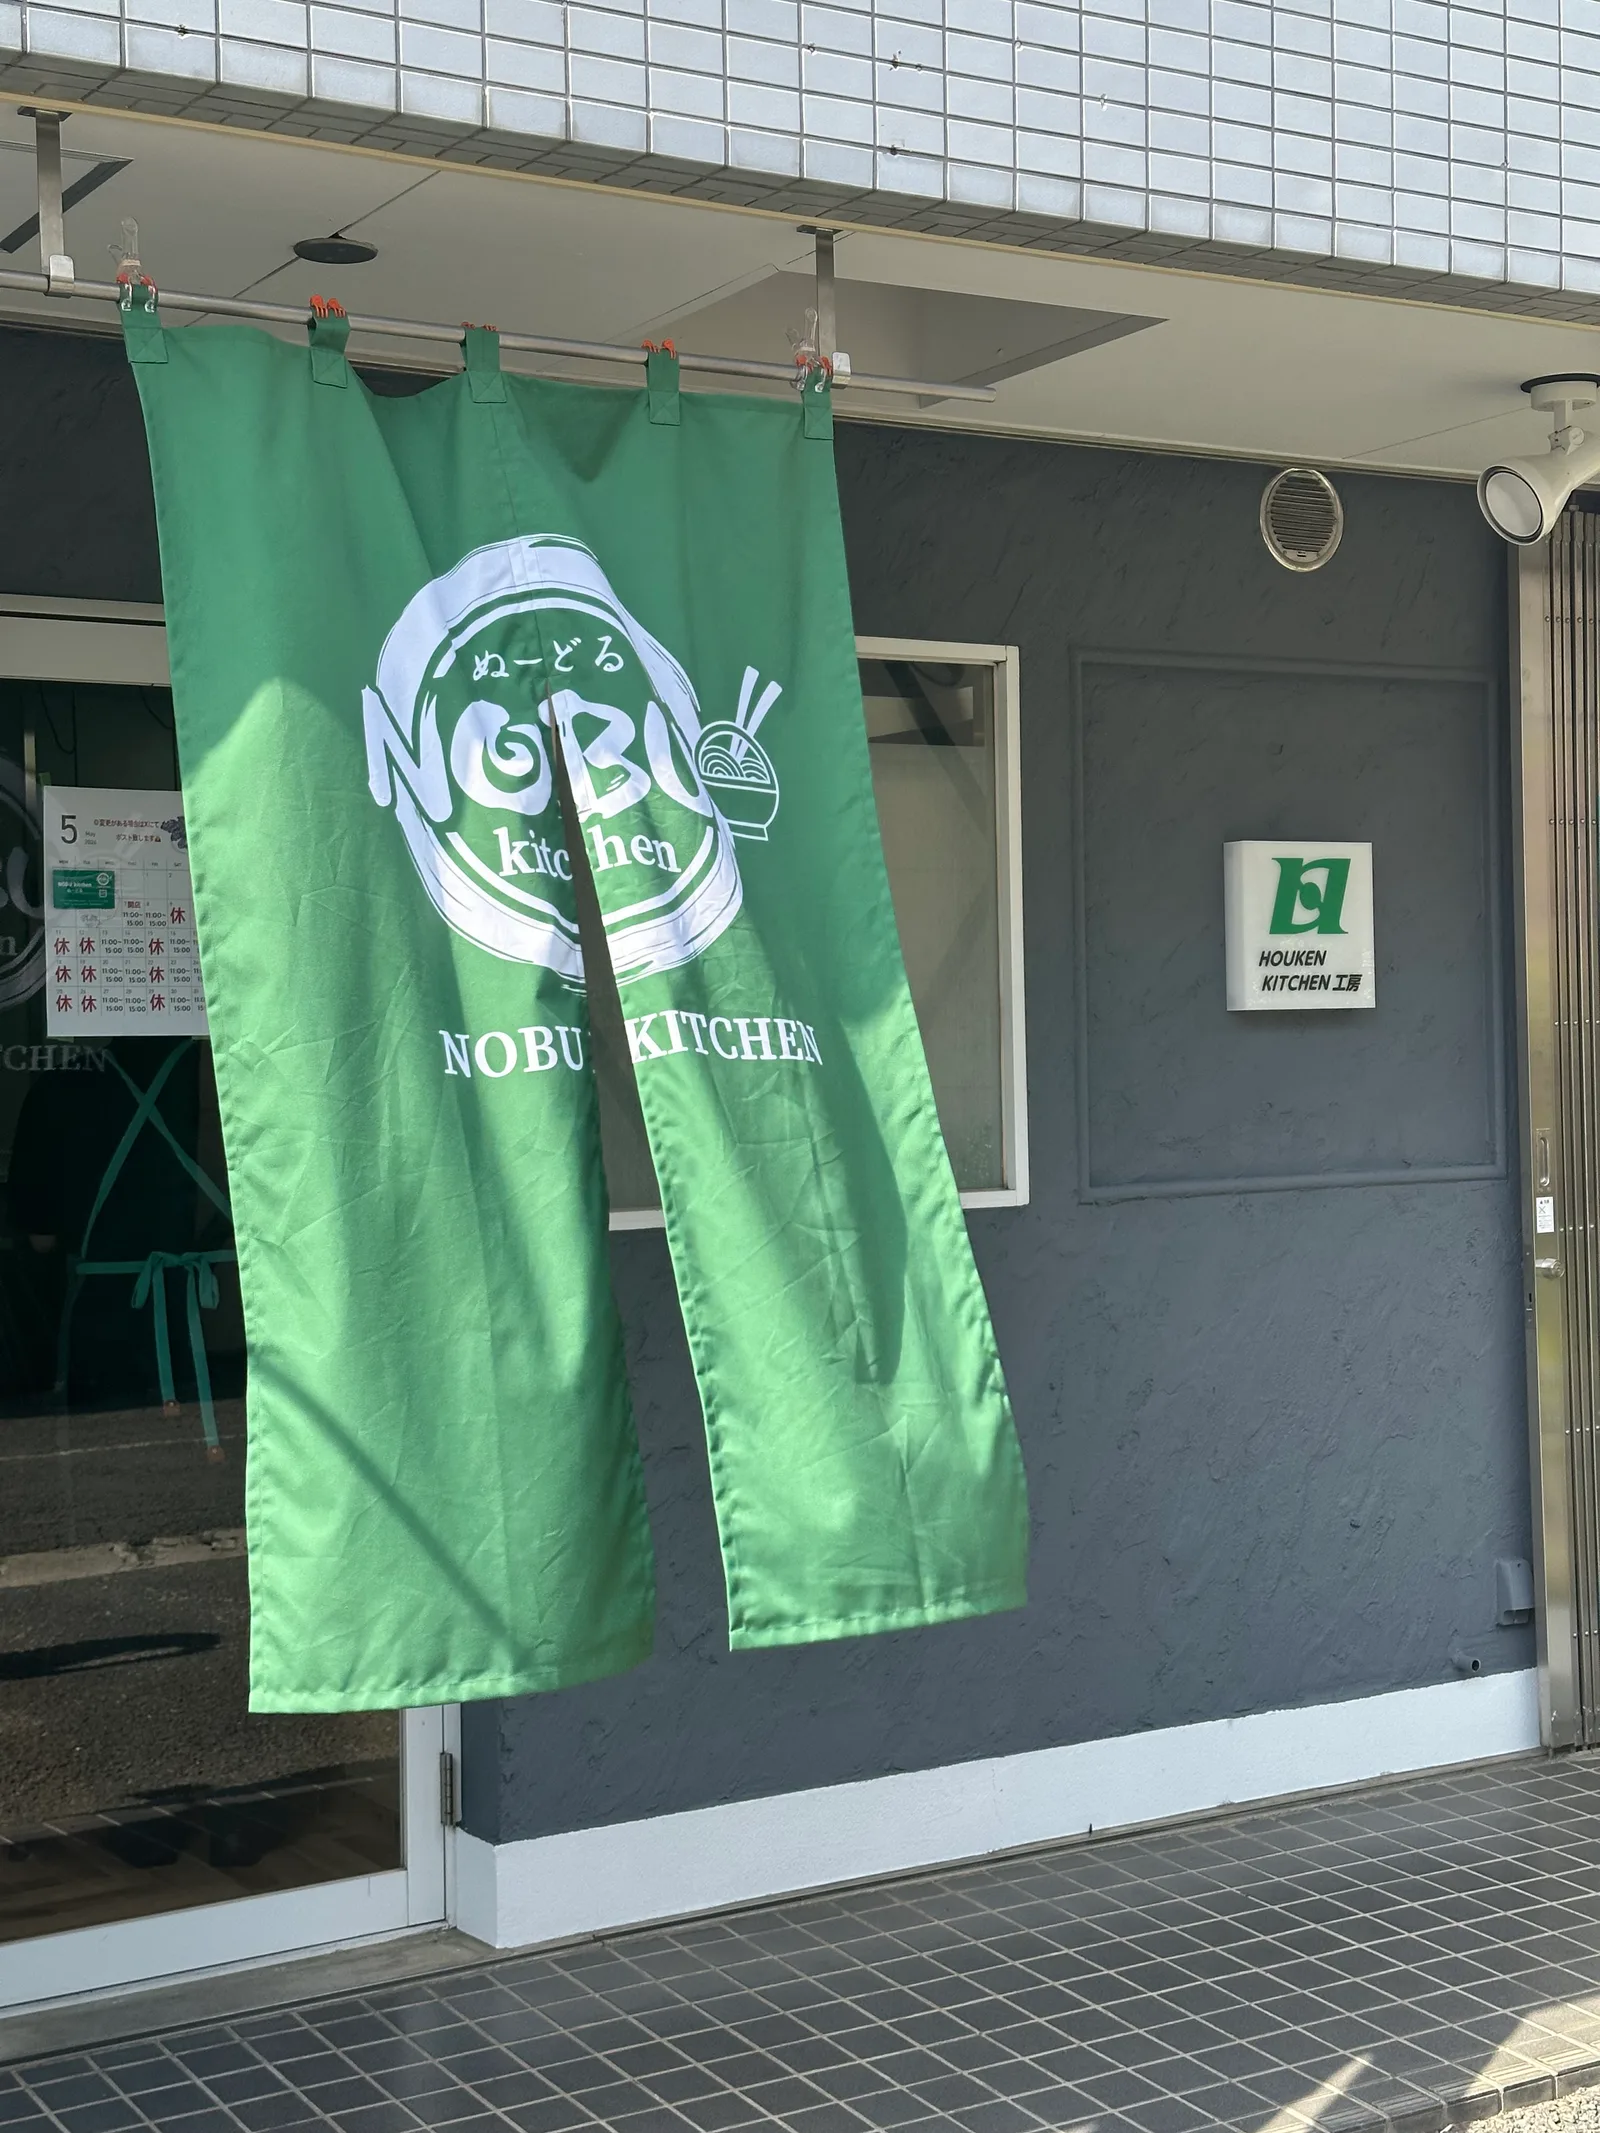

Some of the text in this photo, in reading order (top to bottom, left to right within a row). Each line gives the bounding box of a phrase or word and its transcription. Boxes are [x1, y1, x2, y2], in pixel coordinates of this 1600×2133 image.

[473, 635, 624, 681] ぬーどる
[361, 685, 714, 823] NOBU
[60, 814, 78, 845] 5
[493, 824, 682, 881] kitchen
[170, 906, 186, 925] 休
[54, 937, 71, 955] 休
[79, 937, 96, 955] 休
[148, 938, 165, 955] 休
[1258, 950, 1328, 967] HOUKEN
[55, 965, 72, 983] 休
[81, 965, 97, 983] 休
[129, 976, 146, 984] 15:00
[149, 966, 165, 984] 休
[1261, 974, 1363, 992] KITCHEN 工房
[56, 994, 73, 1012] 休
[81, 995, 97, 1013] 休
[150, 993, 166, 1012] 休
[438, 1010, 823, 1078] NOBU KITCHEN
[0, 1043, 106, 1074] CHEN
